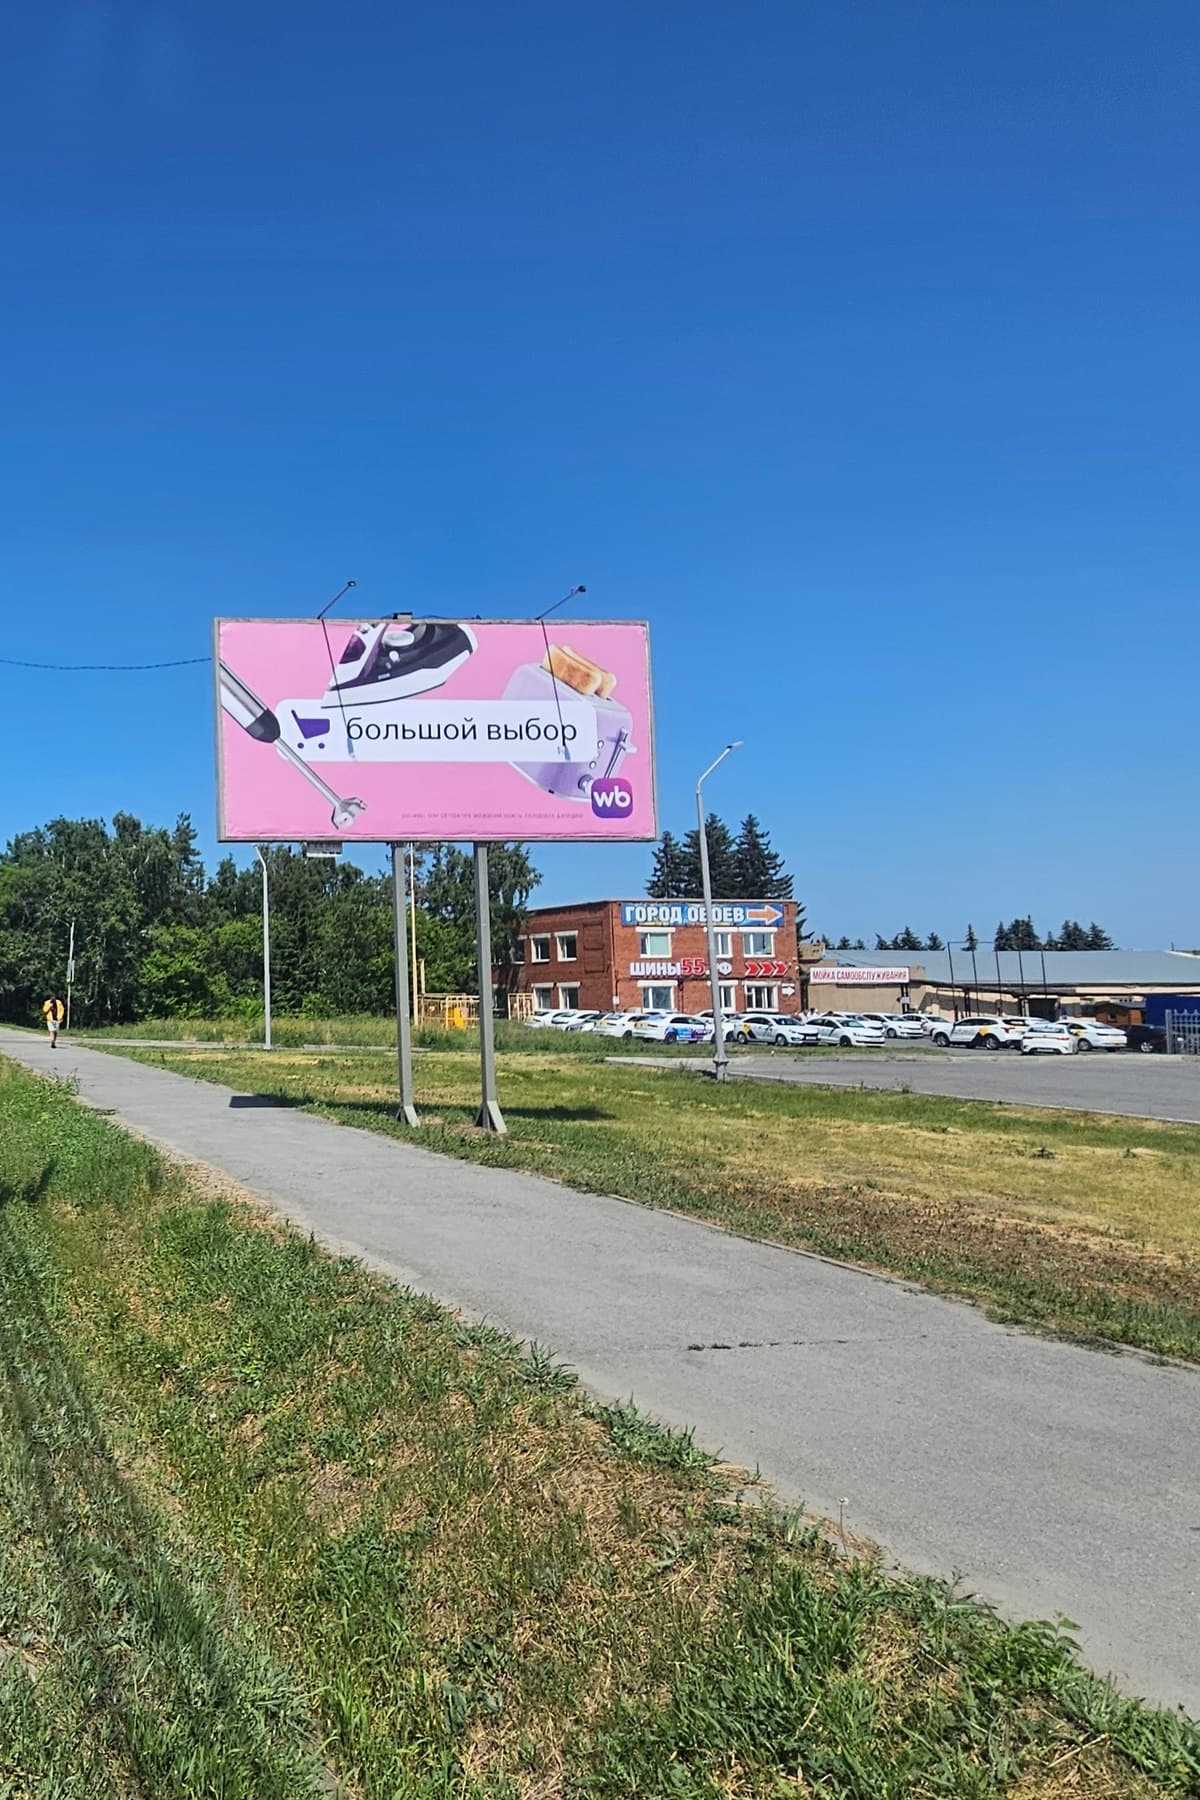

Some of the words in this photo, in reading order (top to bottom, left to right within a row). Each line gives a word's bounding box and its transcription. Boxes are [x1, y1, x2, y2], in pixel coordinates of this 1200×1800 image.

[346, 716, 478, 741] большой
[487, 717, 578, 747] выбор
[592, 785, 631, 808] wb
[625, 906, 682, 925] ГОРОД
